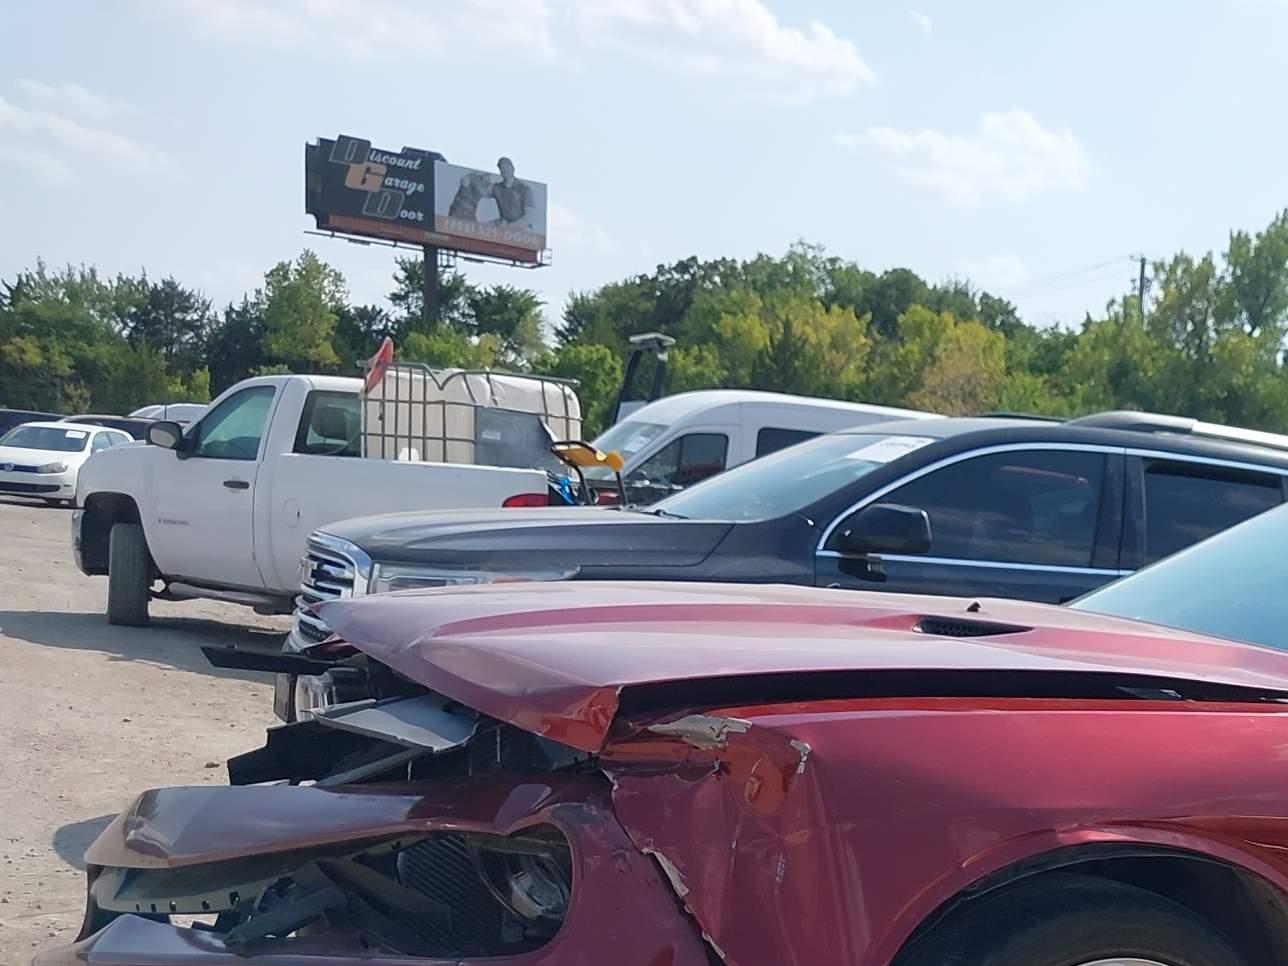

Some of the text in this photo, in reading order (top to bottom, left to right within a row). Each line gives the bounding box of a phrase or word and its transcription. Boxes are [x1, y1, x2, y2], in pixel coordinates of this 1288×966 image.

[328, 134, 422, 170] Discount
[345, 161, 425, 195] Garage
[362, 188, 425, 221] Door
